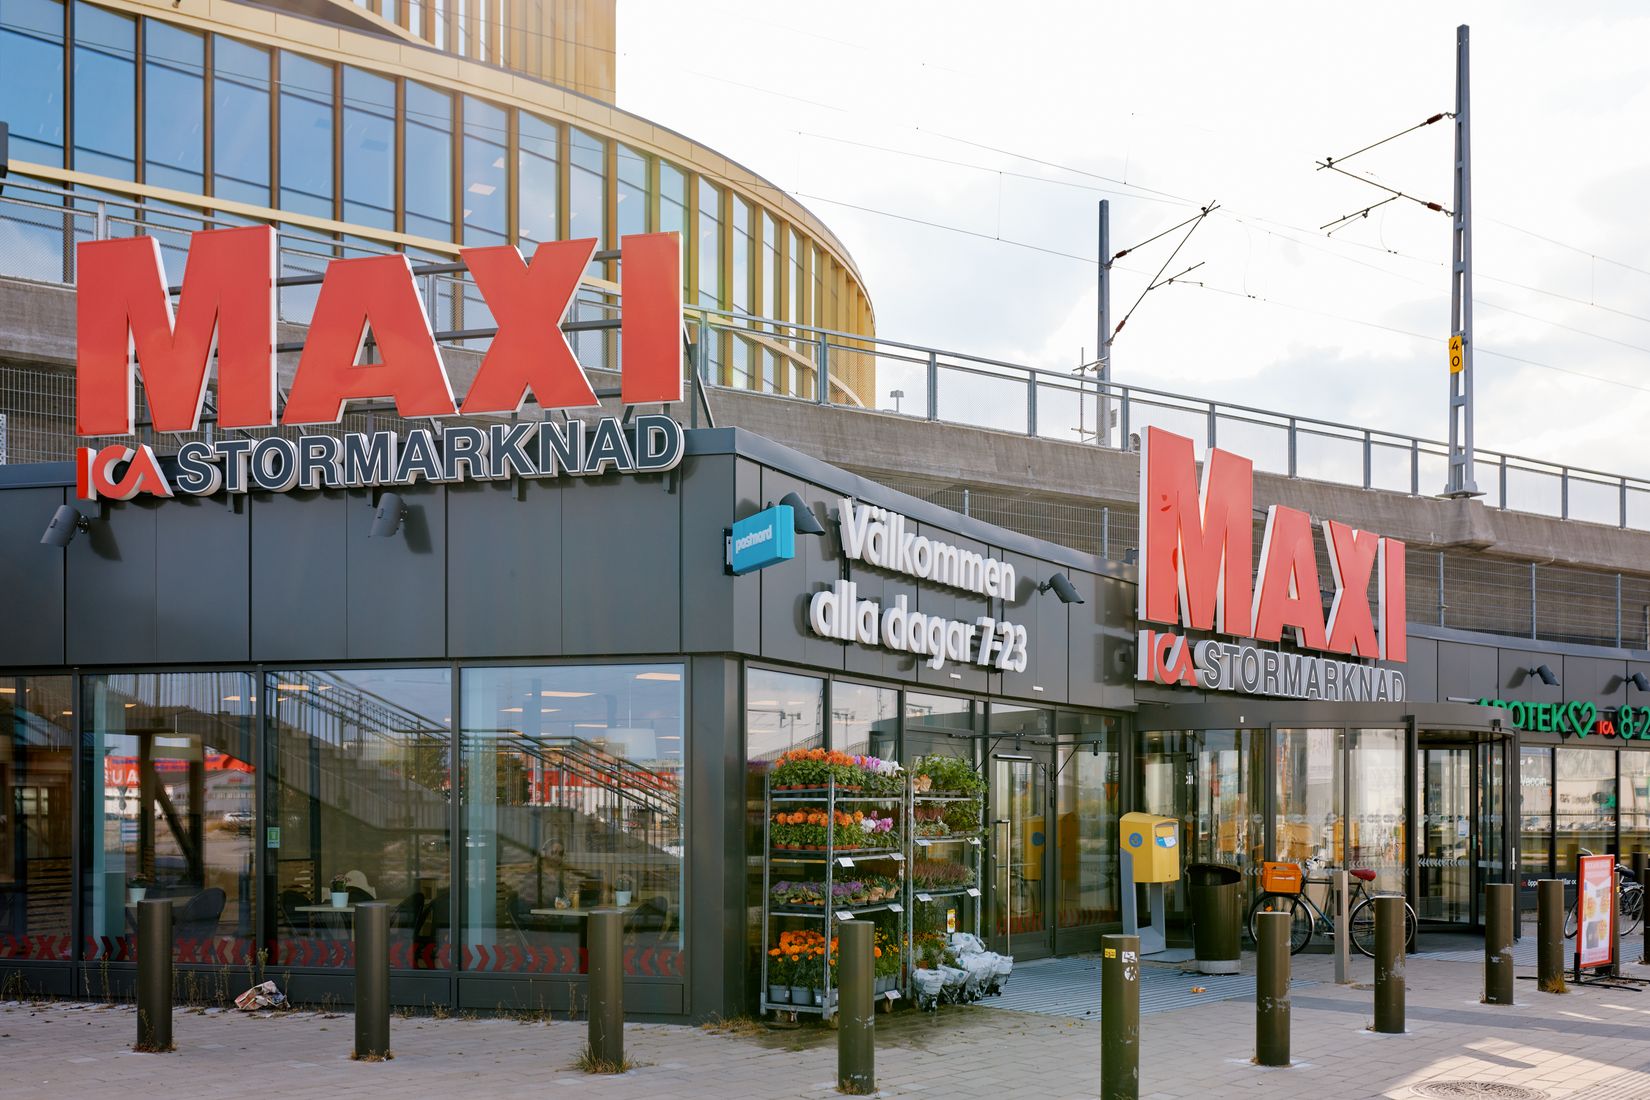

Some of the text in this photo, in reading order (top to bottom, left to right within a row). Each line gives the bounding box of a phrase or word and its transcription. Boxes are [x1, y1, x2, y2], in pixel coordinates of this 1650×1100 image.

[76, 224, 684, 436] MAXI
[76, 414, 684, 500] ICA STORMARKNAD
[735, 524, 773, 554] postnord
[838, 497, 1016, 602] Välkommen
[1138, 425, 1407, 663] MAXI
[810, 579, 1028, 673] alla dagar 7-23
[1138, 629, 1407, 702] ICA STORMARKNAD
[1479, 698, 1568, 733] OTEK
[1597, 720, 1616, 736] ICA
